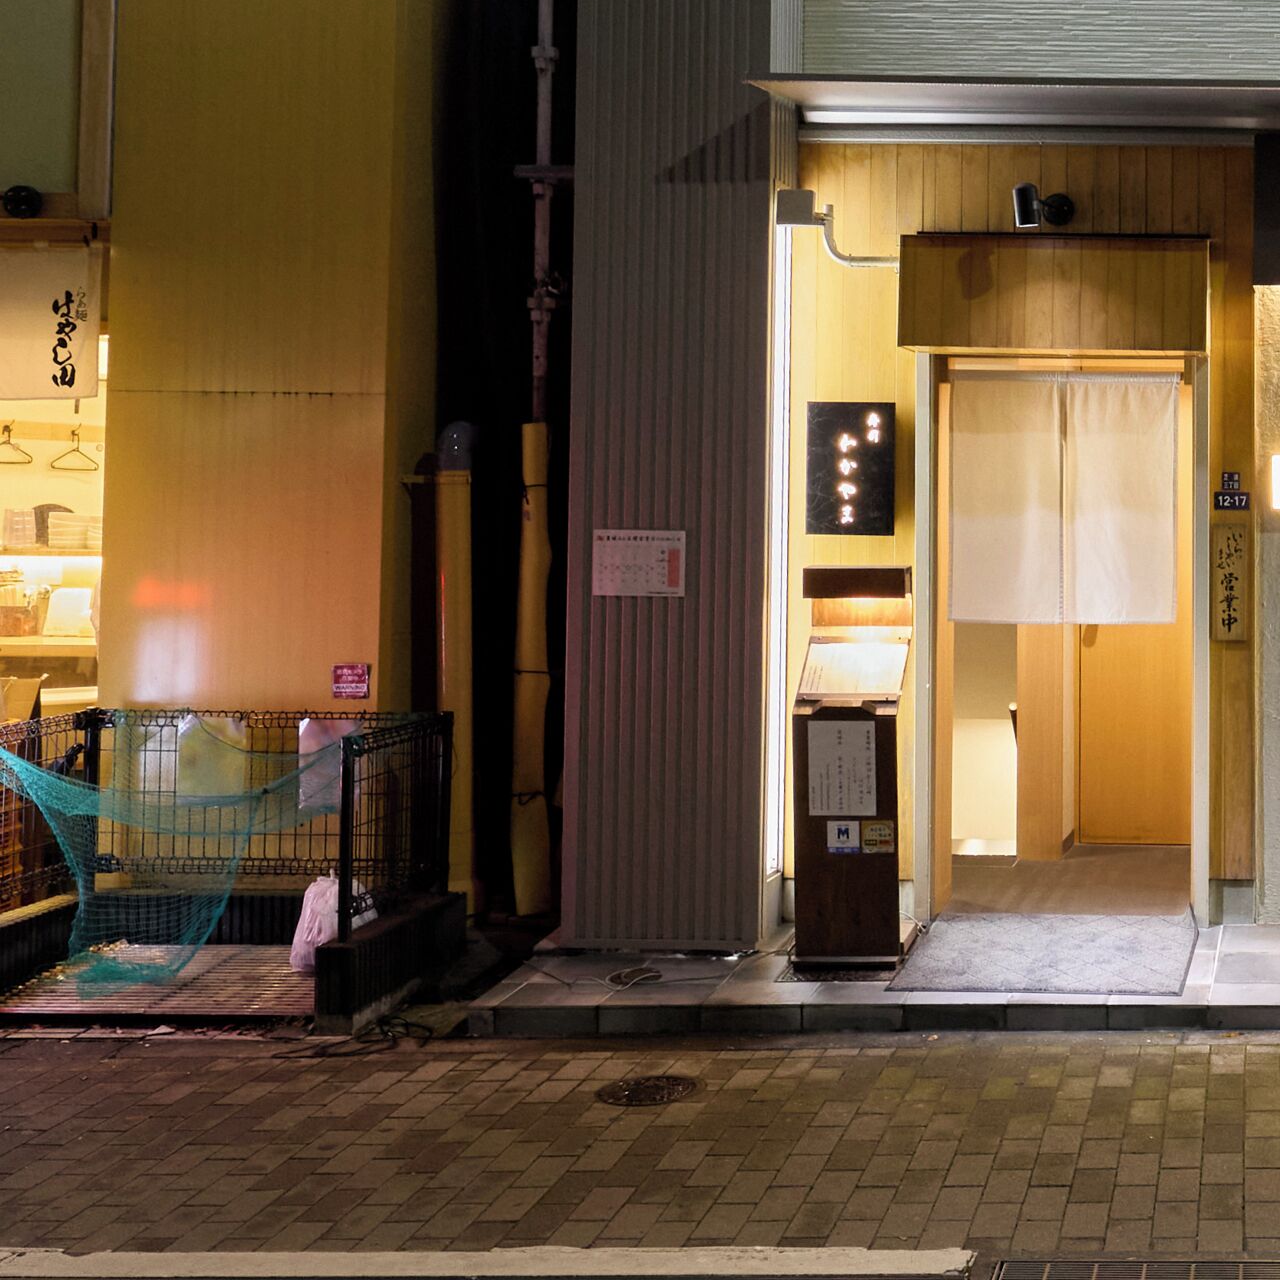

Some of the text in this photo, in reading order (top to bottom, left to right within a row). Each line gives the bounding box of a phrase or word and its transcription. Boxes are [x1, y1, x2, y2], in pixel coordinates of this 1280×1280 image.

[1218, 495, 1247, 507] 12-17
[1219, 572, 1240, 633] 営業中
